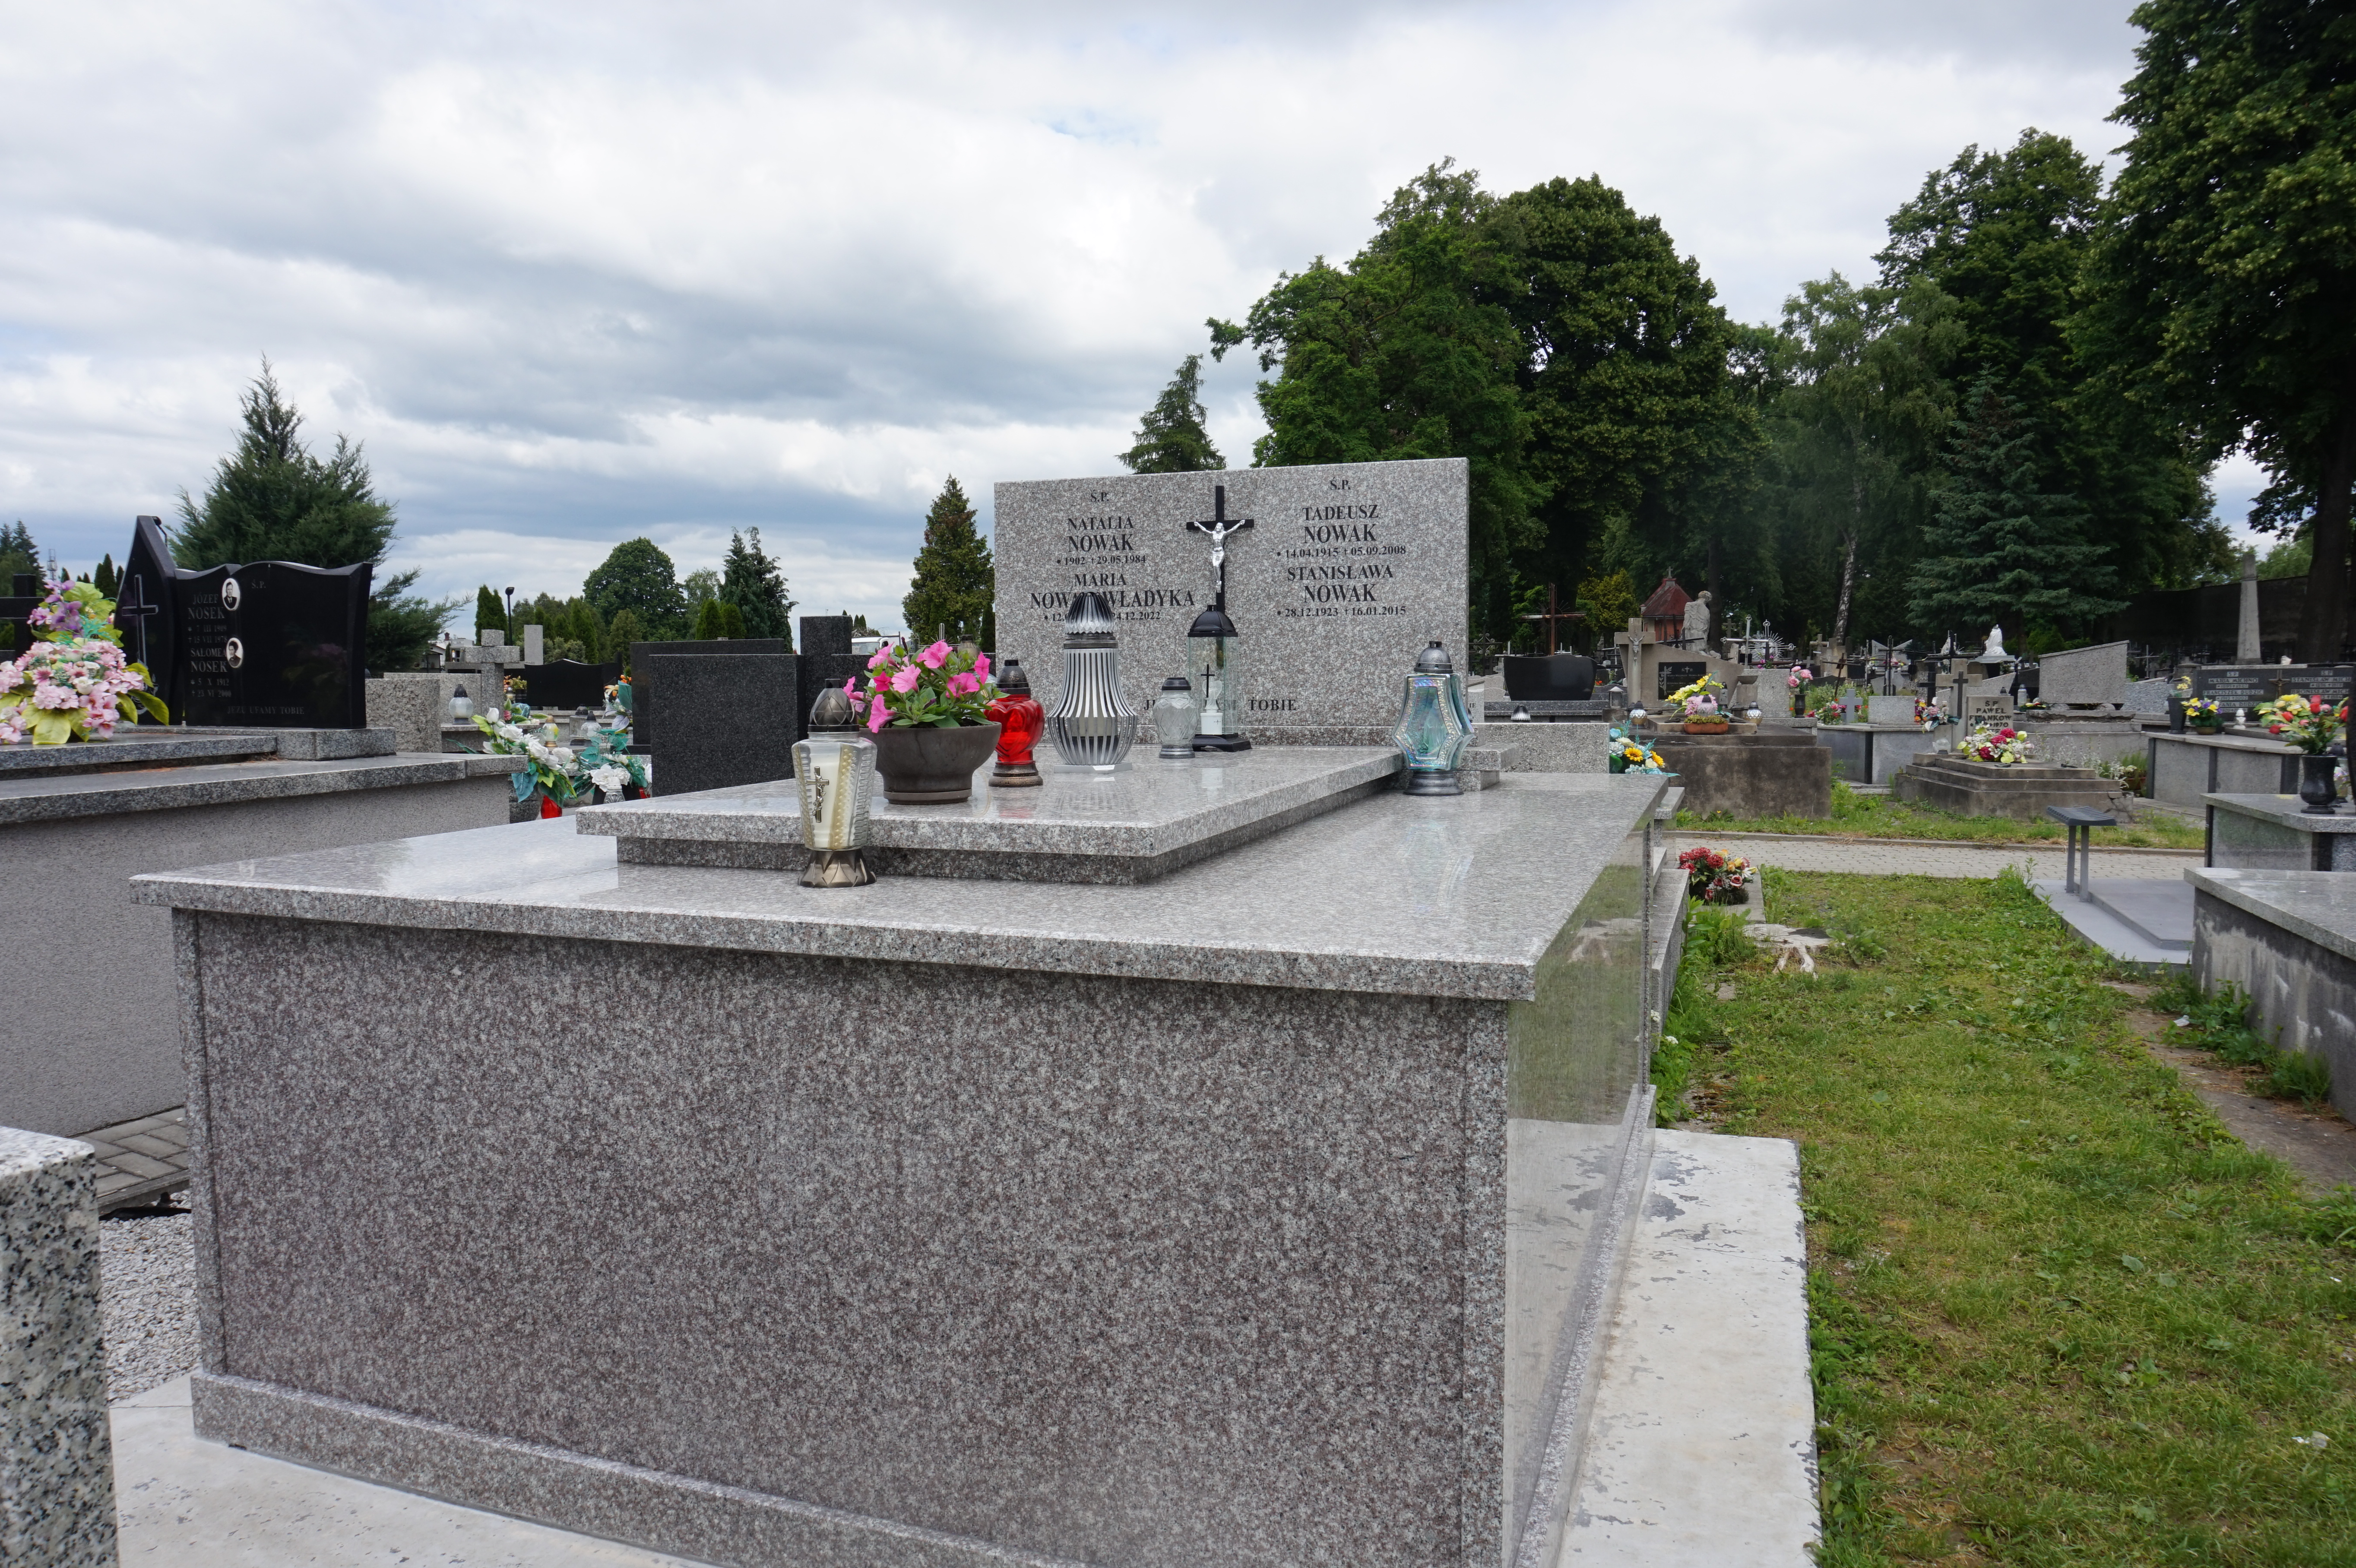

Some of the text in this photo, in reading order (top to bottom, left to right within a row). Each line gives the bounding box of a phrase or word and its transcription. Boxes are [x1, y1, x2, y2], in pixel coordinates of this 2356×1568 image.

[1330, 477, 1350, 490] Ś.P.
[1090, 490, 1109, 503] Ś.P.
[1302, 504, 1379, 521] TADEUSZ
[1067, 515, 1134, 531] NATALIA
[1304, 523, 1377, 544] NOWAK
[1067, 534, 1134, 553] NOWAK
[1286, 545, 1406, 558] 14.04.1915 05.09.2008
[1065, 554, 1146, 566] 1902 29.05.1984
[1287, 564, 1394, 581] STANISŁAWA
[1074, 573, 1127, 587] MARIA
[193, 592, 219, 604] JÓZEF
[1304, 584, 1377, 603] NOWAK
[188, 607, 225, 620] NOSEK
[1285, 606, 1406, 617] 28.12.1923 16.01.2015
[190, 648, 227, 658] SALOMEA
[191, 661, 228, 672] NOSEK
[227, 705, 305, 714] JEZU UFAMY TOBIE
[1248, 699, 1296, 711] TOBIE
